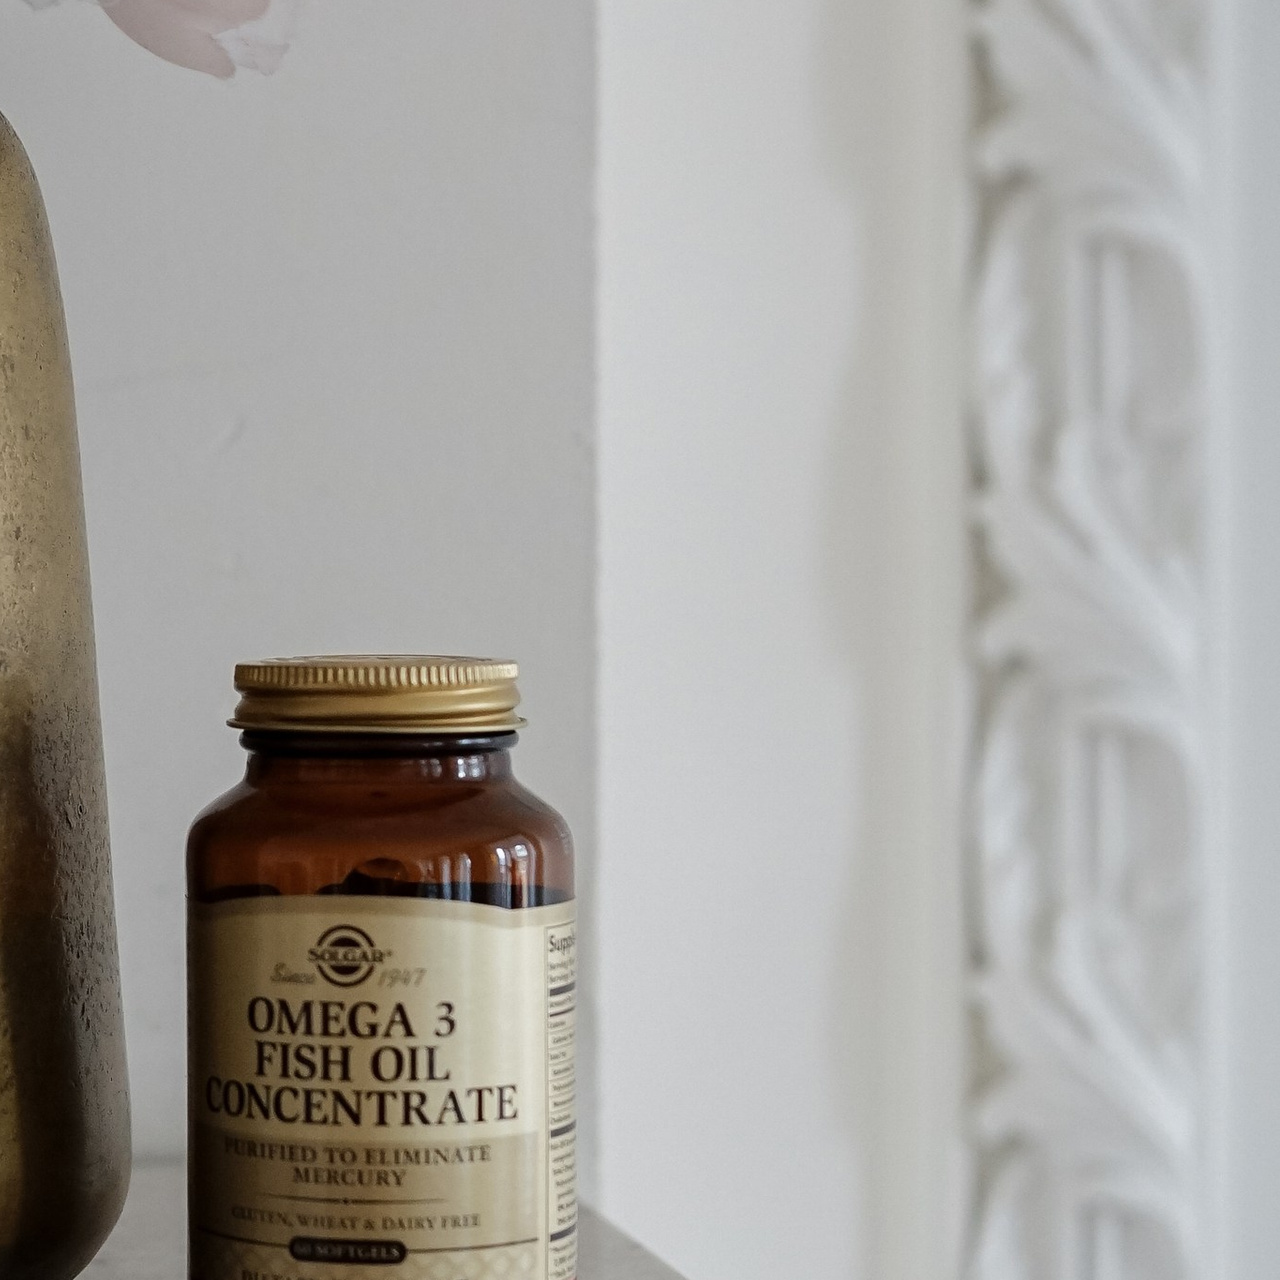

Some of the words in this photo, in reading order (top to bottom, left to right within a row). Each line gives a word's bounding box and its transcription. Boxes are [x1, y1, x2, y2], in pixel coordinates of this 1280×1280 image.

[270, 963, 315, 985] Since
[378, 968, 426, 988] 1947
[248, 996, 416, 1038] OMEGA
[435, 1002, 455, 1038] 3
[255, 1040, 352, 1082] FISH
[371, 1046, 450, 1082] OIL
[206, 1076, 518, 1127] CONCENTRATE
[224, 1138, 318, 1164] PURIFIED
[324, 1147, 357, 1165] TO
[365, 1144, 491, 1165] ELIMINATE
[292, 1168, 407, 1187] MERCURY
[231, 1205, 293, 1228] GLUTEN,
[297, 1213, 358, 1230] WHEAT
[363, 1218, 374, 1230] &
[381, 1216, 435, 1231] DAIRY
[441, 1214, 481, 1229] FREE
[313, 1243, 400, 1260] SOFTGELS
